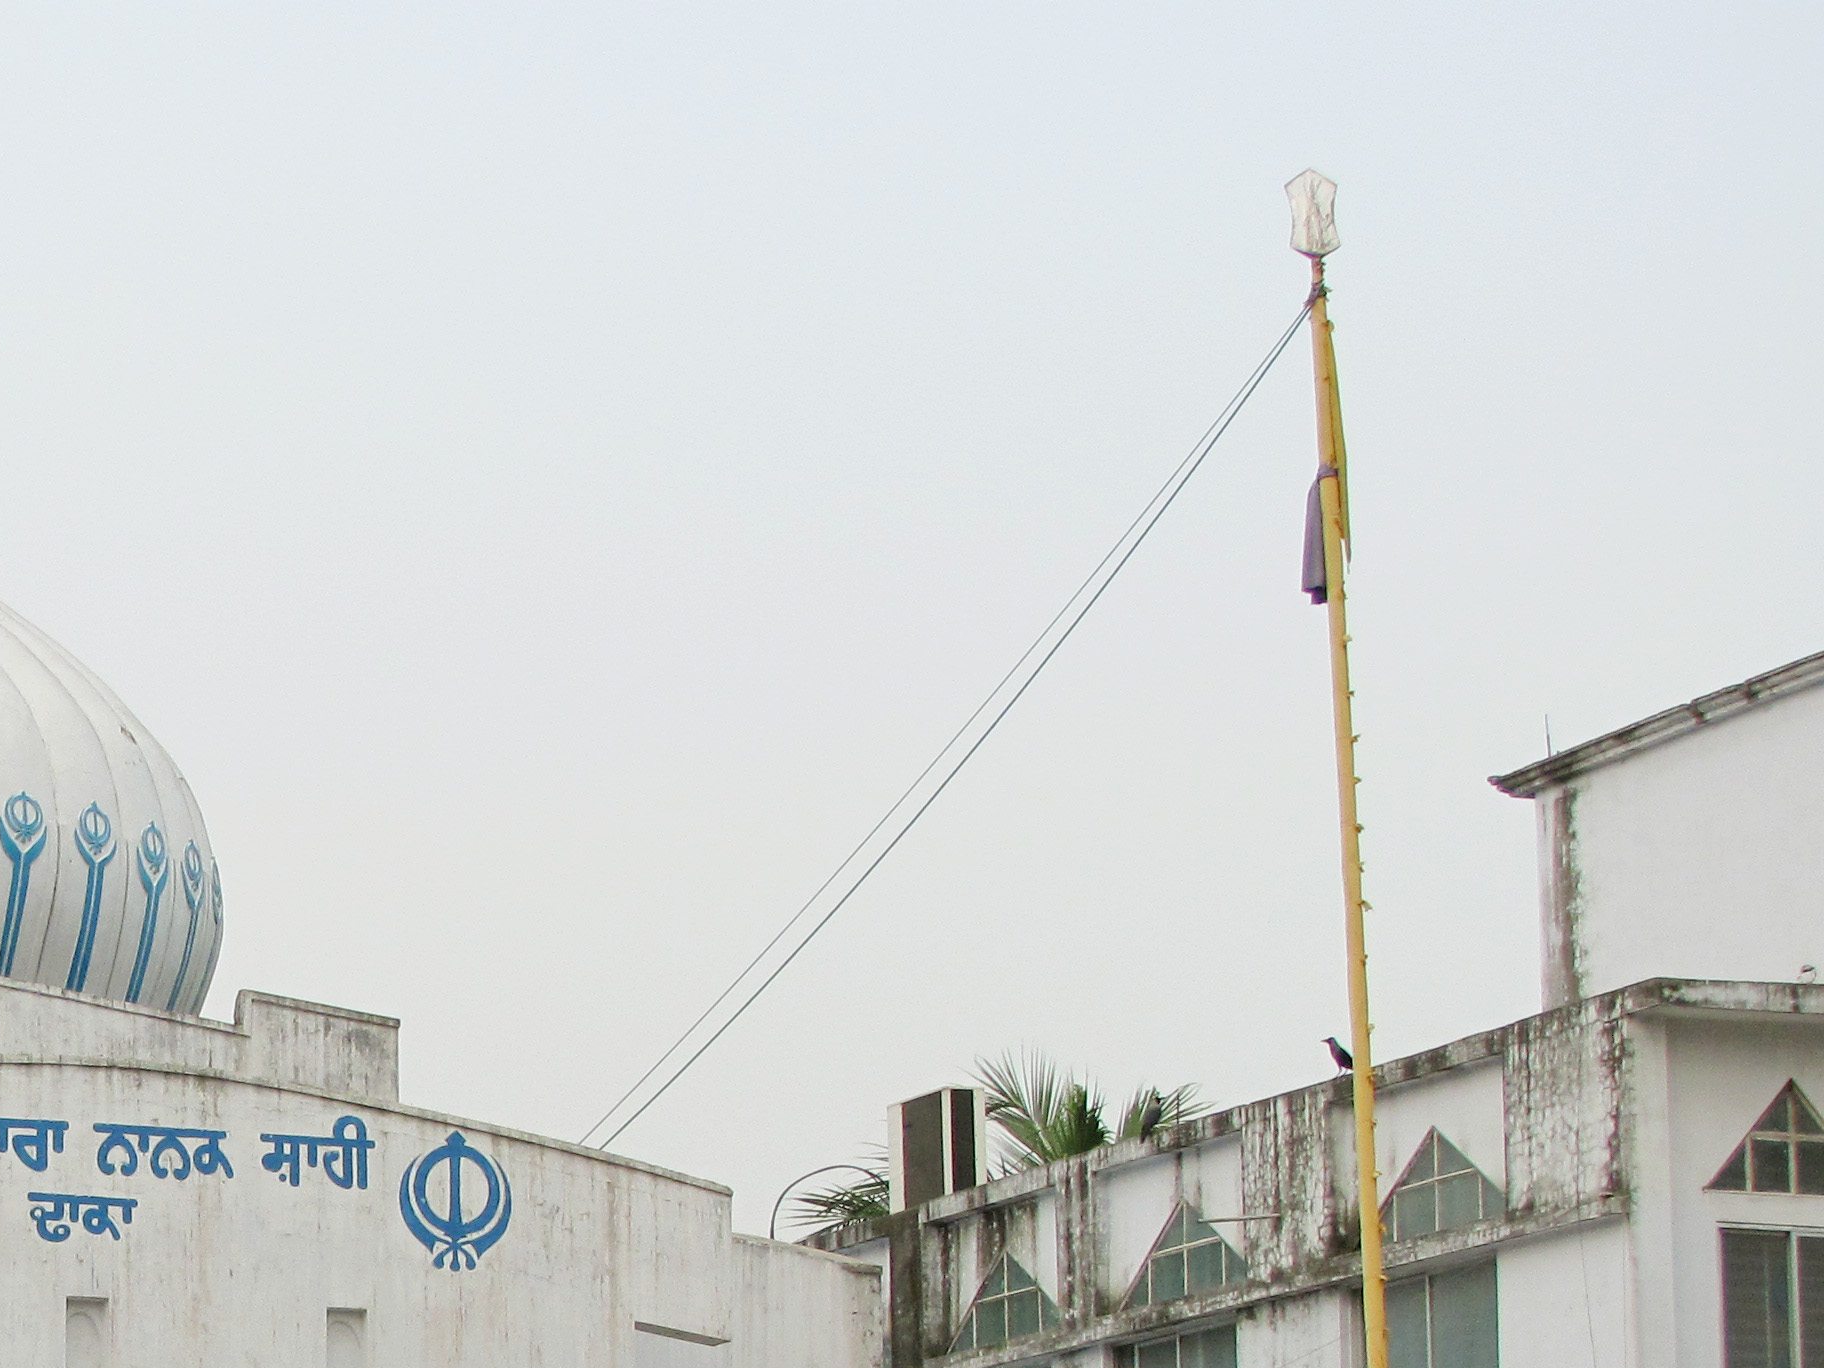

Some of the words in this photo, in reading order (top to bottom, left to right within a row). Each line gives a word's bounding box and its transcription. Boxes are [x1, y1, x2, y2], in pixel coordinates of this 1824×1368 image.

[93, 1122, 234, 1180] ਨਾਨਕ
[261, 1115, 375, 1189] ਸ਼ਾਹੀ
[27, 1191, 138, 1242] ਢਾਕਾ
